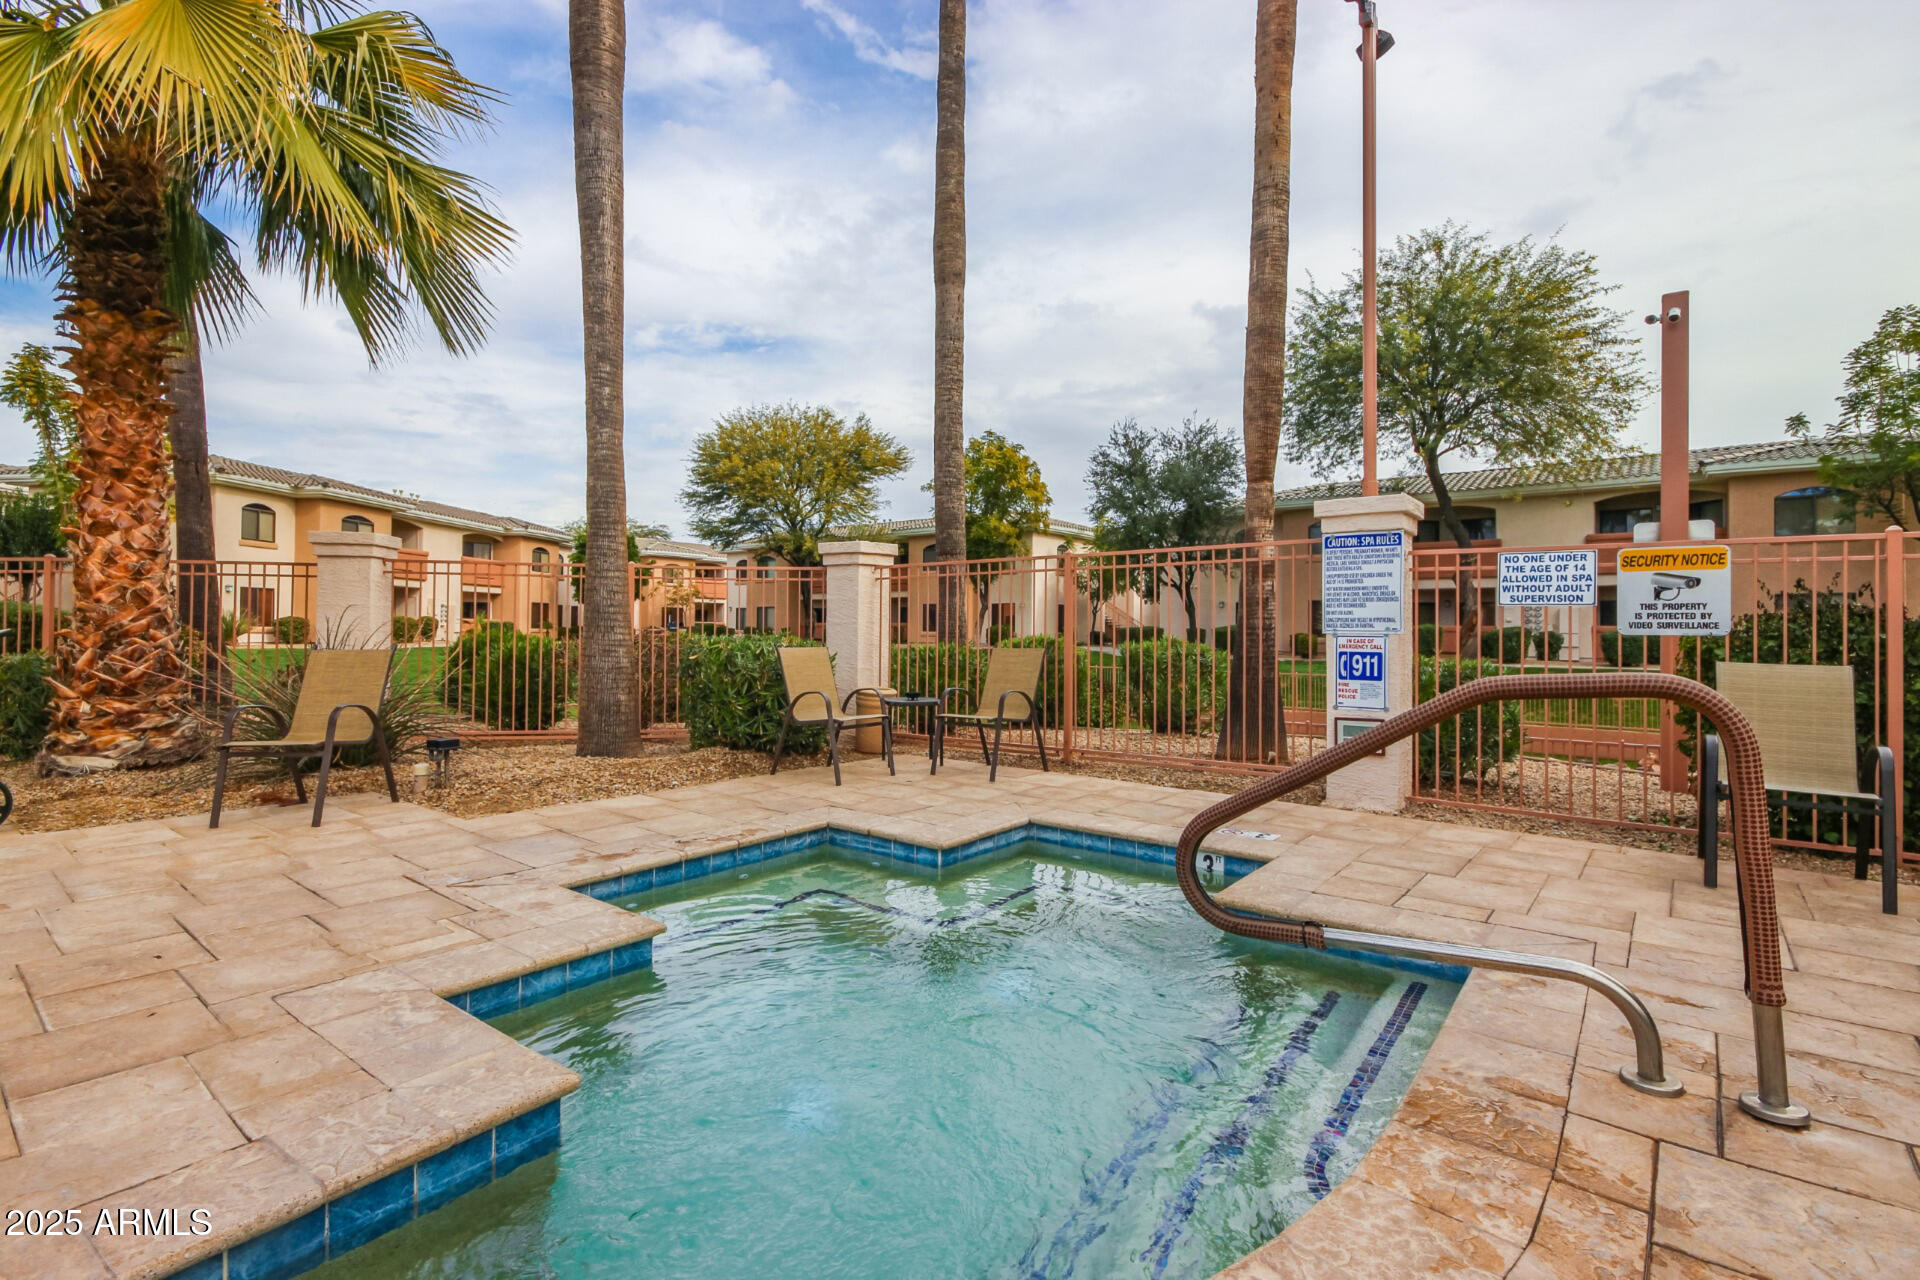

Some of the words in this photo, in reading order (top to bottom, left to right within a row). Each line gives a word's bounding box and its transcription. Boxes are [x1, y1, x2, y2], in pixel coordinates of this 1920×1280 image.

[1328, 538, 1360, 547] CAUTION:
[1362, 536, 1374, 545] SPA
[1376, 535, 1398, 544] RULES
[1550, 554, 1587, 562] UNDER
[1622, 555, 1678, 567] SECURITY
[1681, 553, 1725, 565] NOTICE
[1510, 594, 1583, 602] SUPERVISION
[1352, 654, 1378, 676] 911
[1203, 855, 1214, 872] 3
